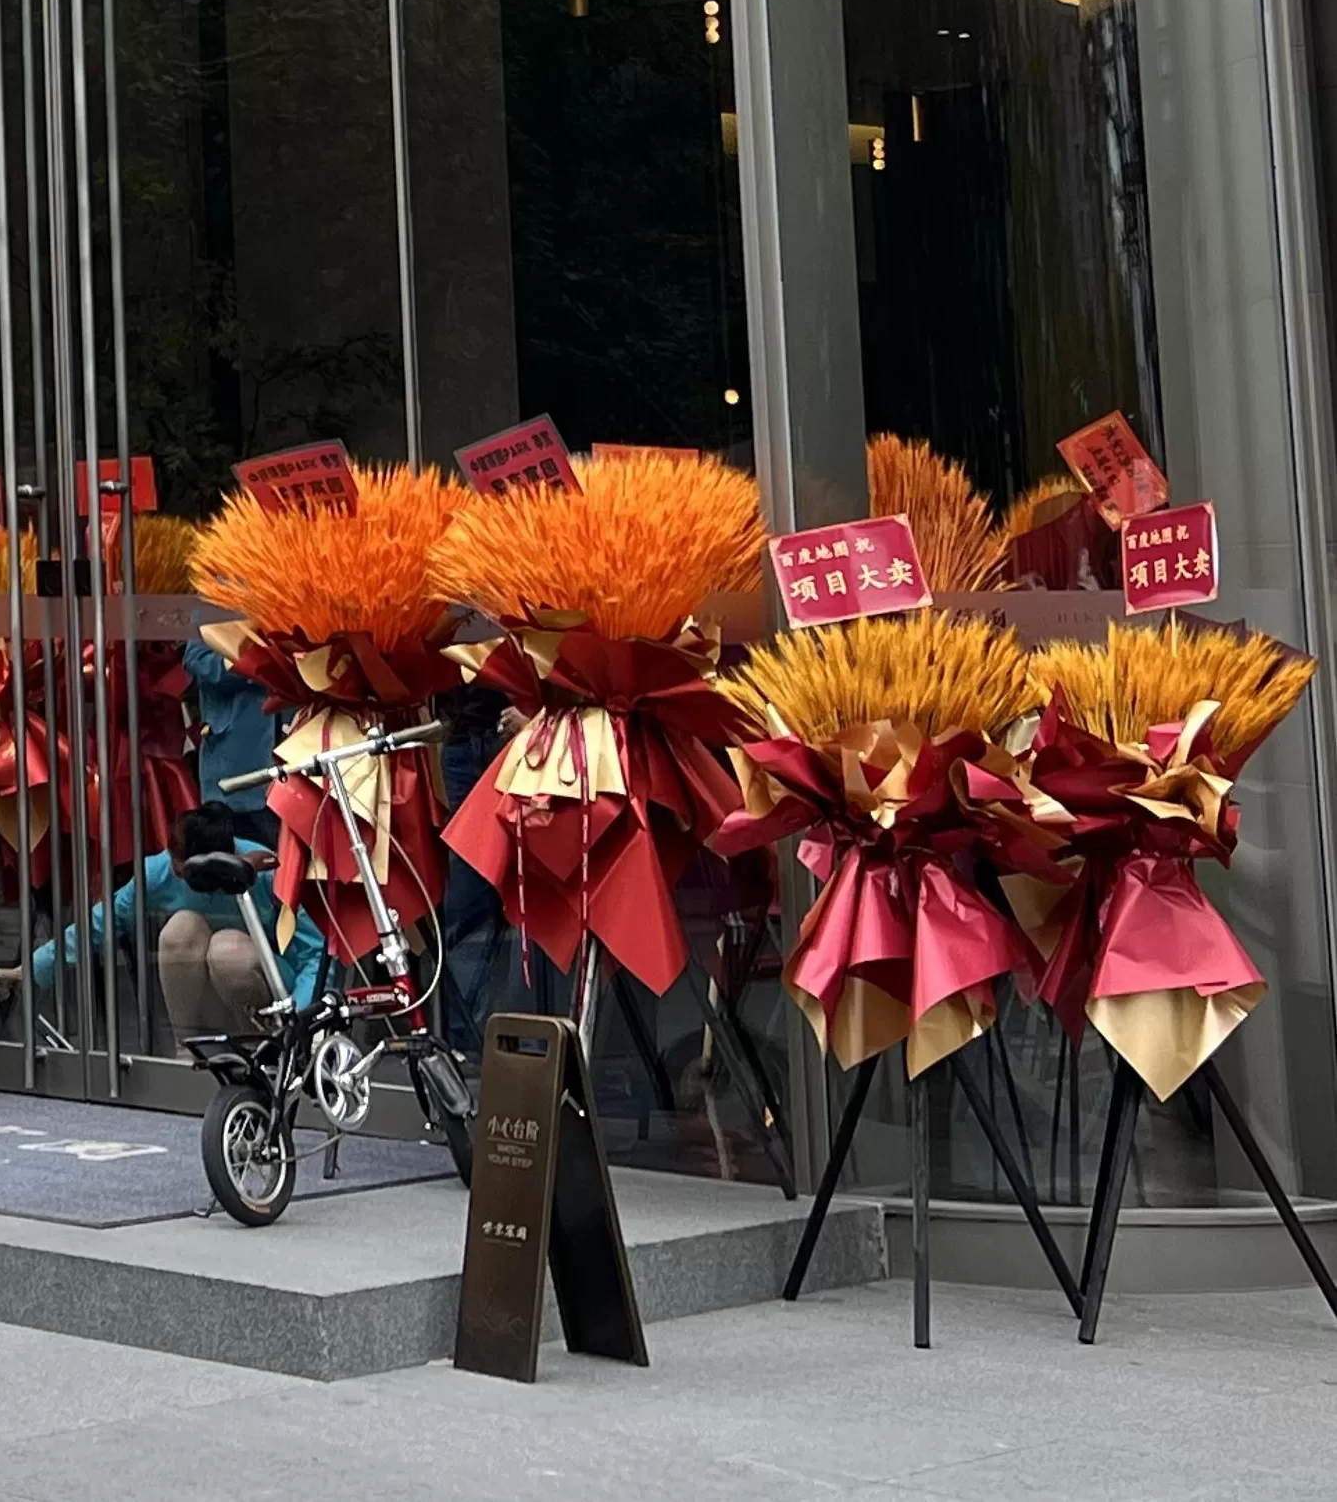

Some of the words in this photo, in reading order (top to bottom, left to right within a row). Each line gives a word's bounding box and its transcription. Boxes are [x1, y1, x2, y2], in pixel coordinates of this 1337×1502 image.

[1125, 526, 1173, 550] 百度地图
[1175, 524, 1190, 542] 祝
[778, 540, 850, 568] 百度地图
[854, 536, 876, 554] 祝
[789, 557, 915, 604] 项目大卖
[1129, 547, 1211, 590] 项目大卖
[487, 1114, 540, 1141] 小心台阶
[487, 1154, 510, 1167] YOUR
[511, 1155, 534, 1169] STEP
[496, 1143, 526, 1155] WATCH
